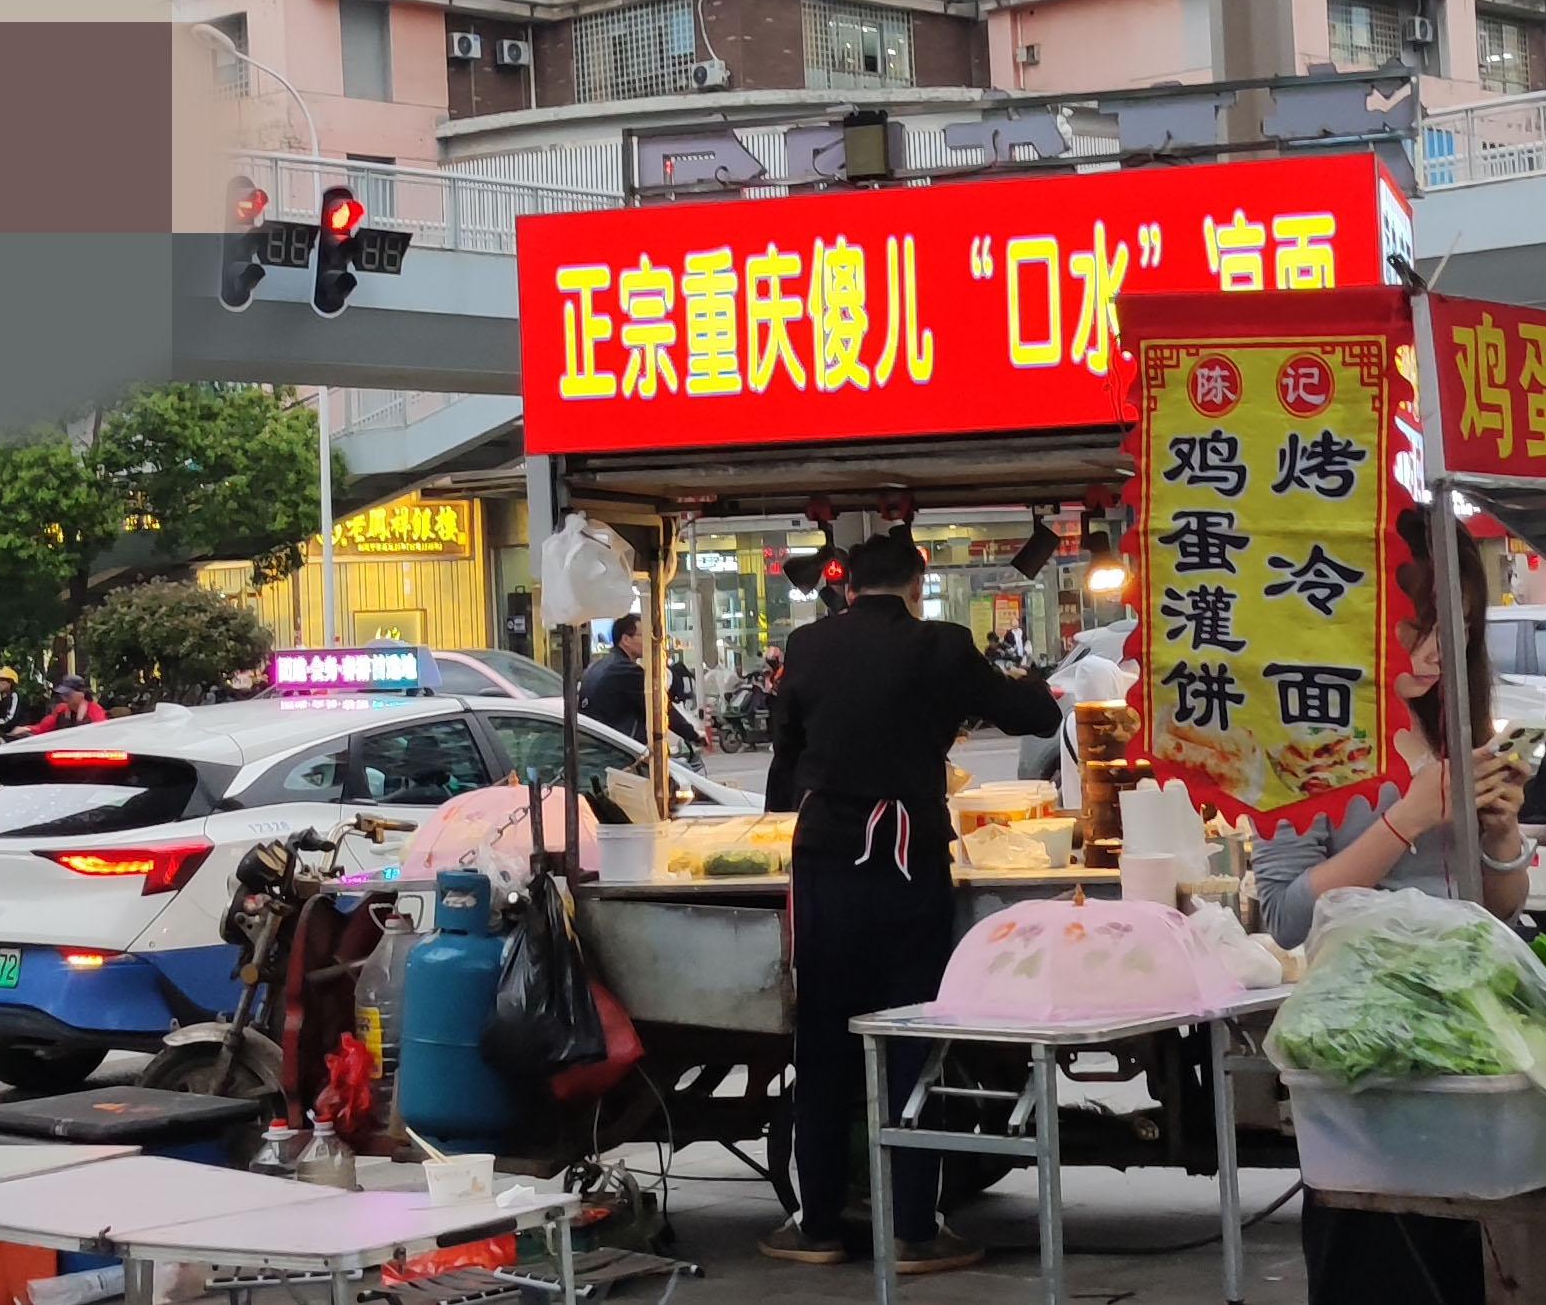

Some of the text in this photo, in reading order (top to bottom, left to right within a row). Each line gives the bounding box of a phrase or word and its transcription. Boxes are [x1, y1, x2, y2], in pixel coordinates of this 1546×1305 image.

[555, 234, 934, 400] 正宗重庆傻儿
[1195, 366, 1328, 406] 陈记
[1157, 429, 1251, 732] 鸡蛋灌饼
[1262, 429, 1367, 728] 烤冷面
